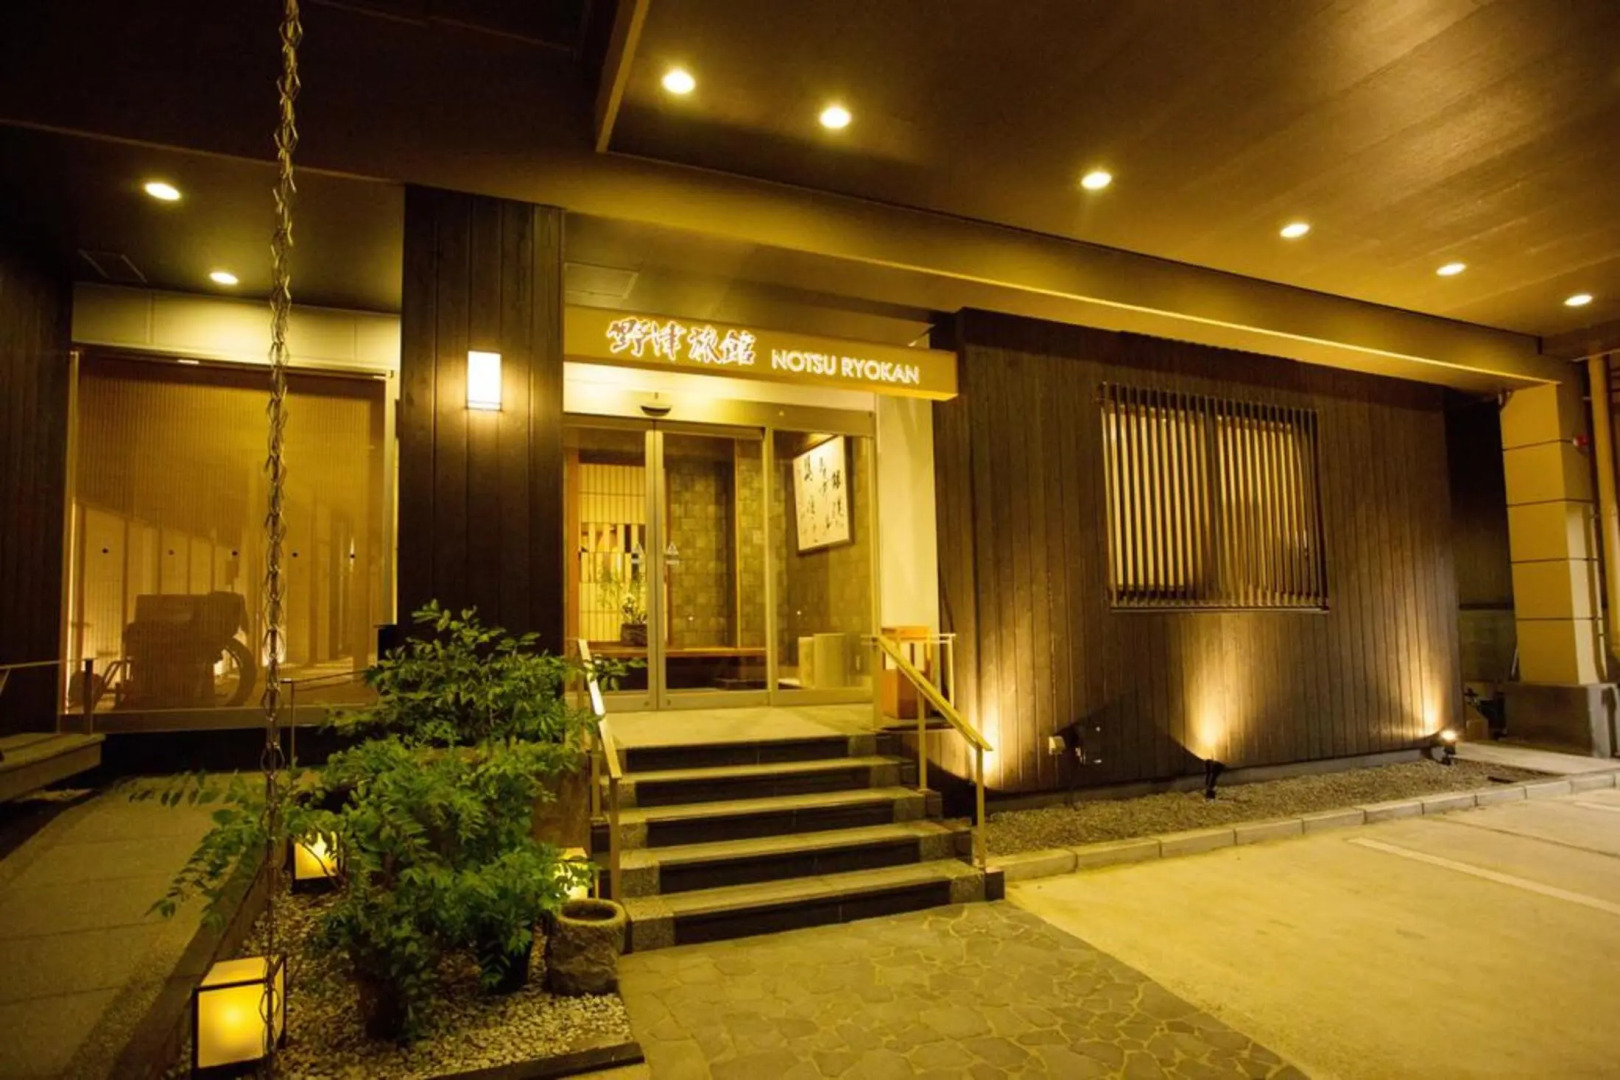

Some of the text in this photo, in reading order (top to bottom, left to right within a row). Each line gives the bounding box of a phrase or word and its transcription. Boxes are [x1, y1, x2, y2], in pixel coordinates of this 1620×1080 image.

[606, 316, 756, 365] 野津旅館
[771, 349, 920, 384] NOTSU RYOKAN
